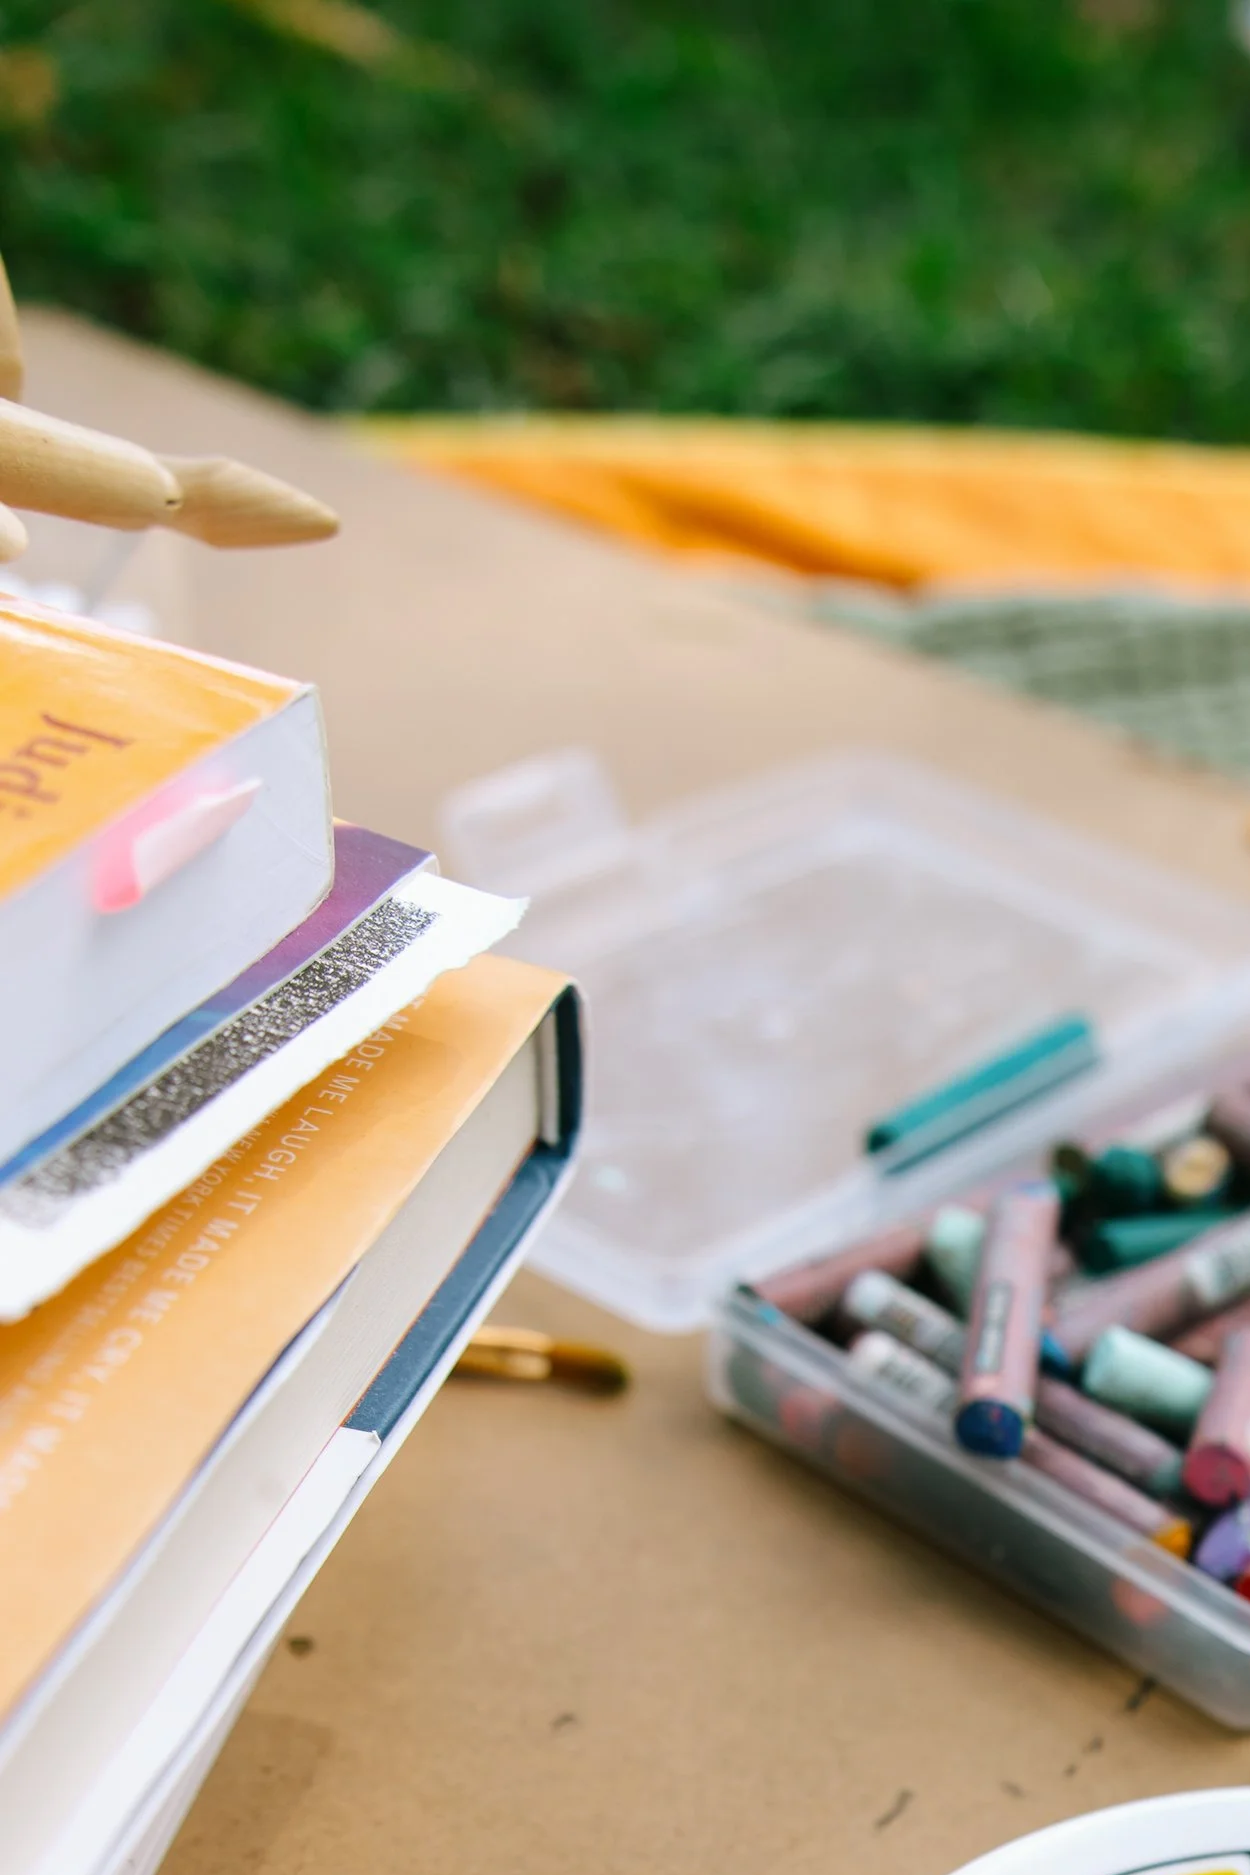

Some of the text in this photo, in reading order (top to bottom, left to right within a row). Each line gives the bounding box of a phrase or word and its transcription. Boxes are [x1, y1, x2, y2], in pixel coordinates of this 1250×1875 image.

[344, 1013, 411, 1072] MADE
[318, 1073, 361, 1105] ME
[243, 1105, 335, 1184] LAUGH,
[186, 1160, 232, 1207] YORK
[226, 1190, 263, 1217] IT
[136, 1205, 194, 1260] TIMES
[162, 1216, 240, 1286] MADE
